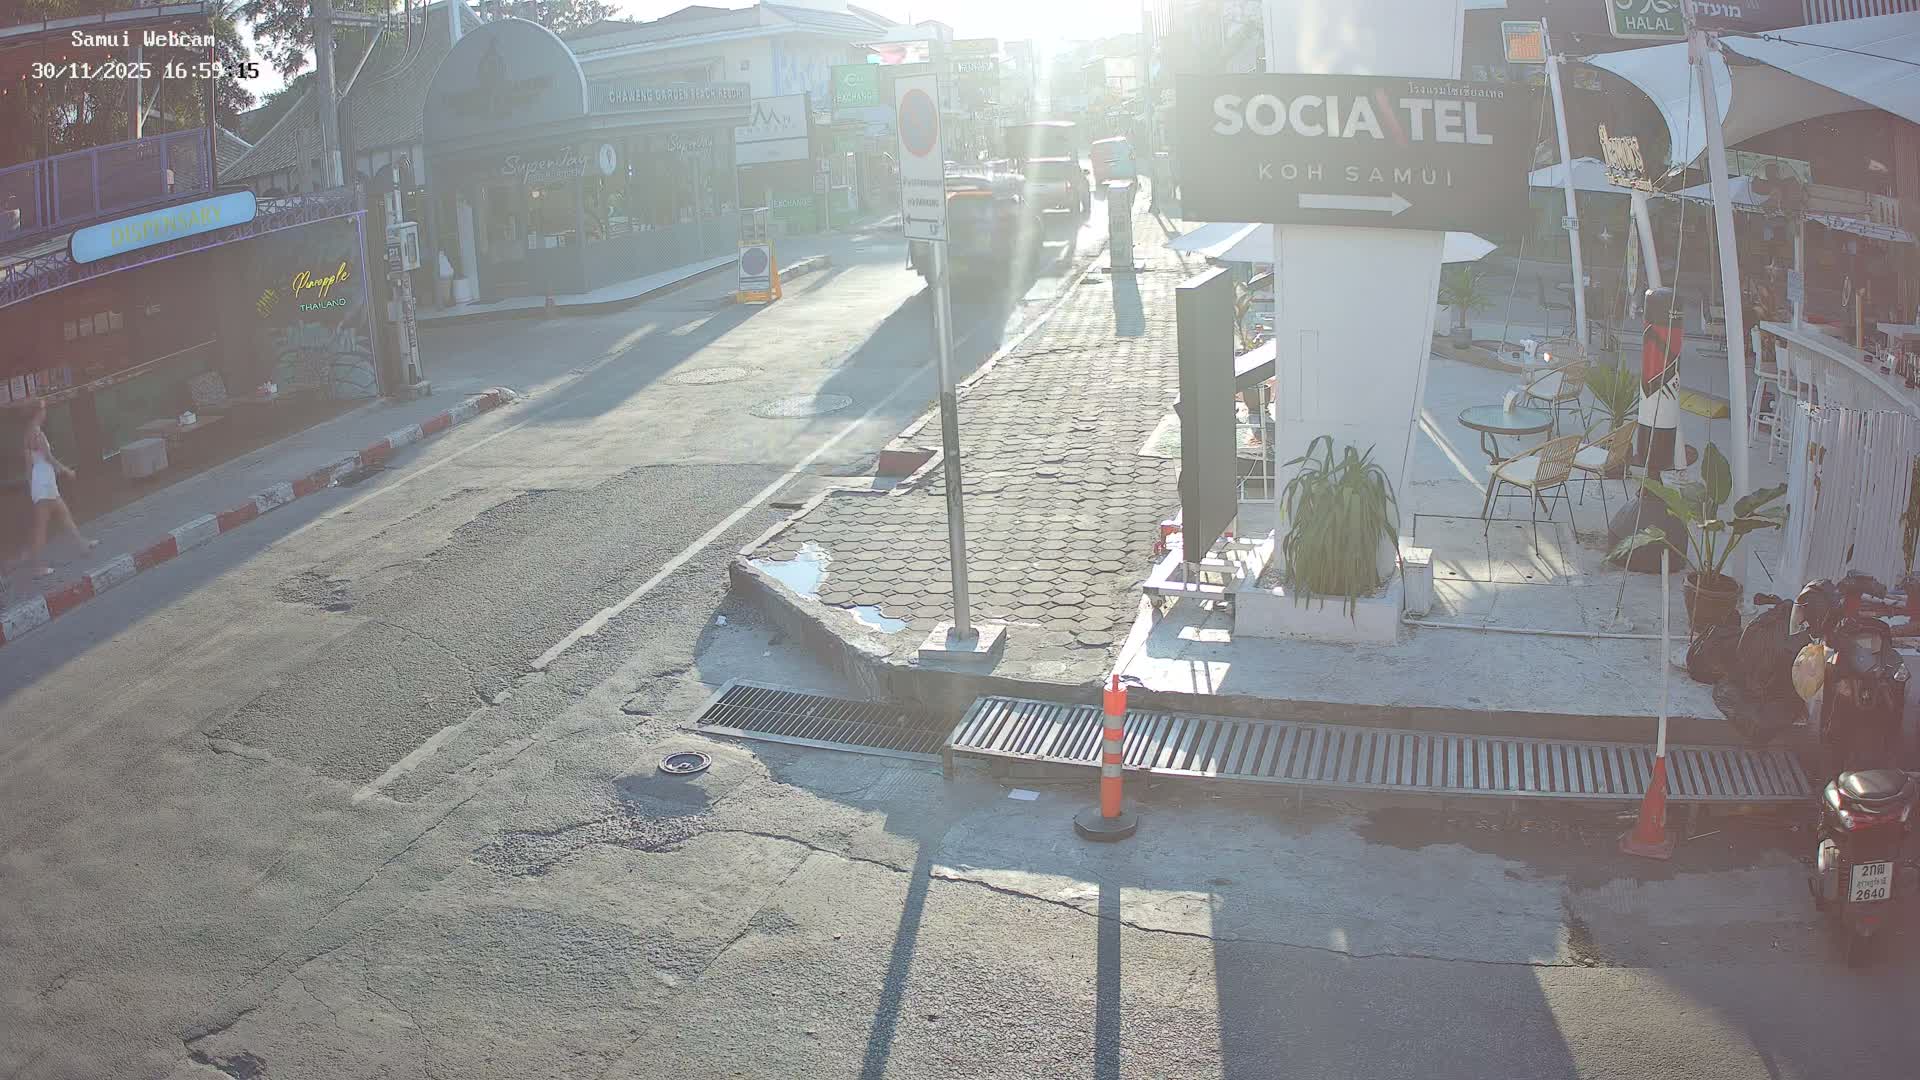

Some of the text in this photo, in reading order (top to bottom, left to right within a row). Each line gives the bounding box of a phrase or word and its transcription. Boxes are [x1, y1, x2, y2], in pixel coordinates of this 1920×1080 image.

[1625, 16, 1674, 31] HALAL
[609, 88, 652, 103] CHAWENG
[1258, 162, 1453, 187] KOH SAMUI
[112, 206, 220, 248] DISPENSARY
[300, 298, 347, 311] THAILAND
[1856, 888, 1885, 900] 2640
